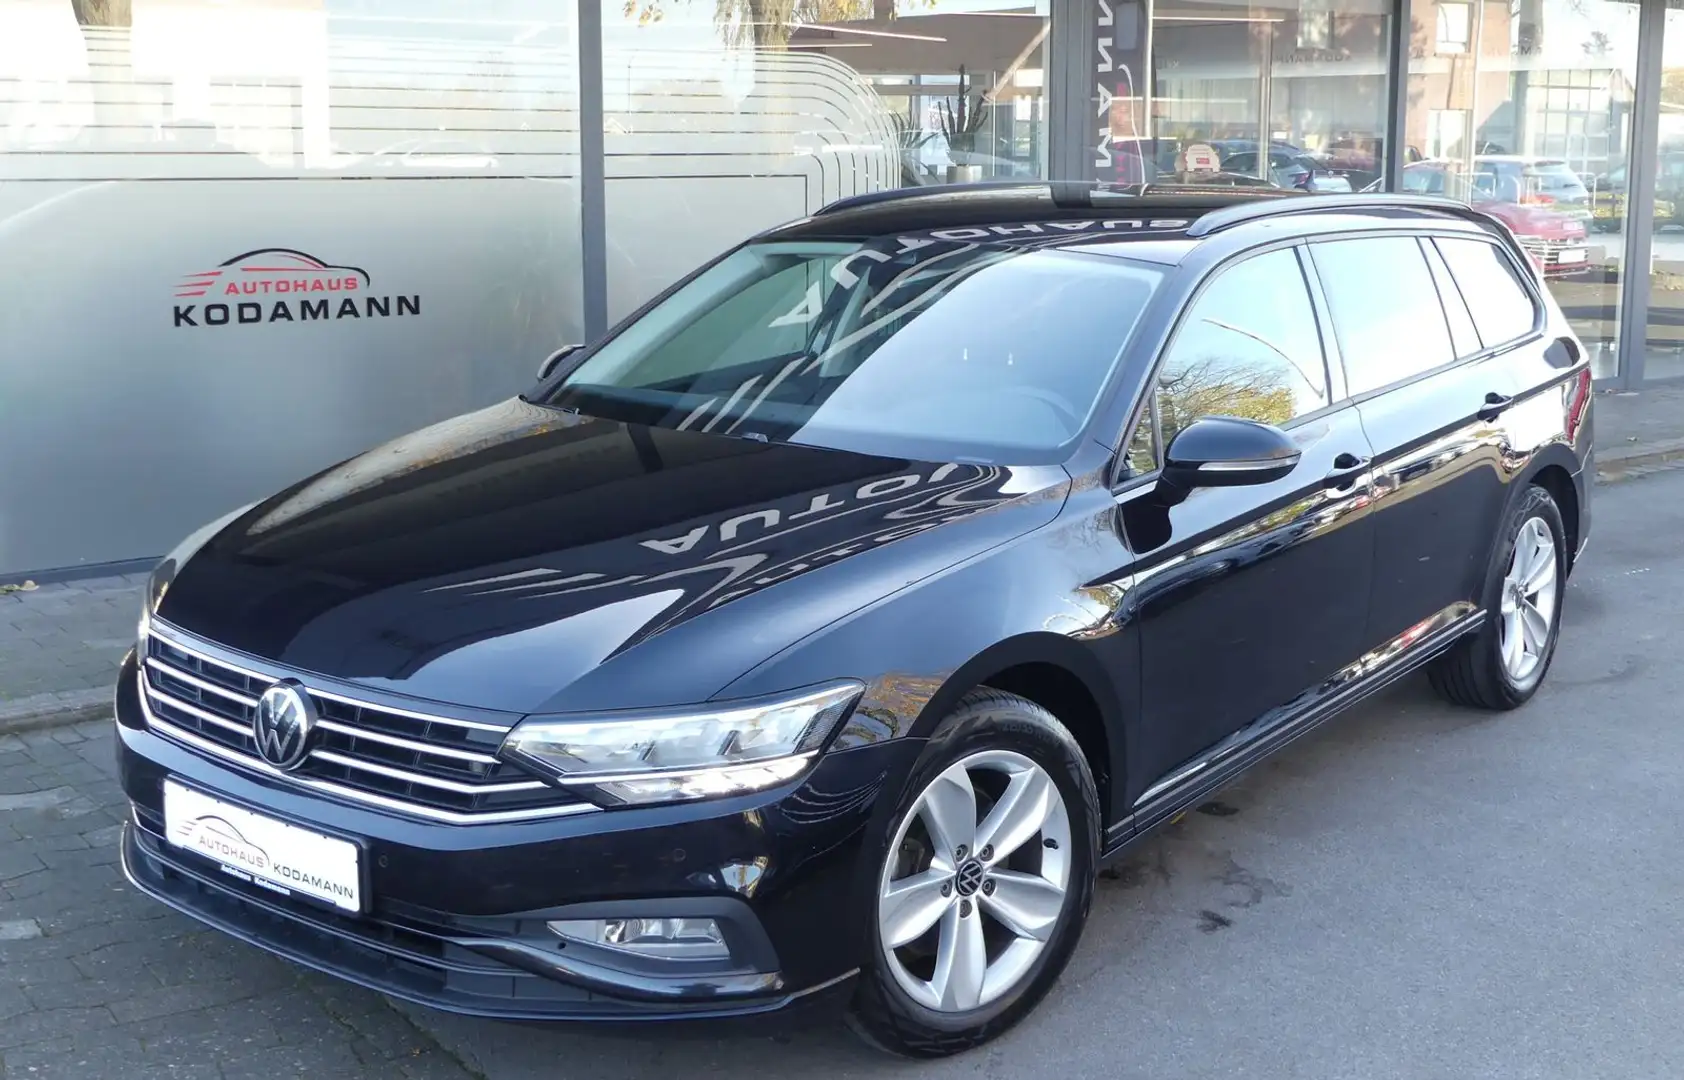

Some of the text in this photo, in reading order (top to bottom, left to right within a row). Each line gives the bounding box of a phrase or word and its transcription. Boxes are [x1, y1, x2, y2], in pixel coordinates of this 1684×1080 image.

[224, 277, 359, 296] AUTOHAUS
[173, 295, 421, 327] KODAMANN
[199, 835, 265, 869] AUTOHAUS
[273, 862, 354, 899] KODAMANN
